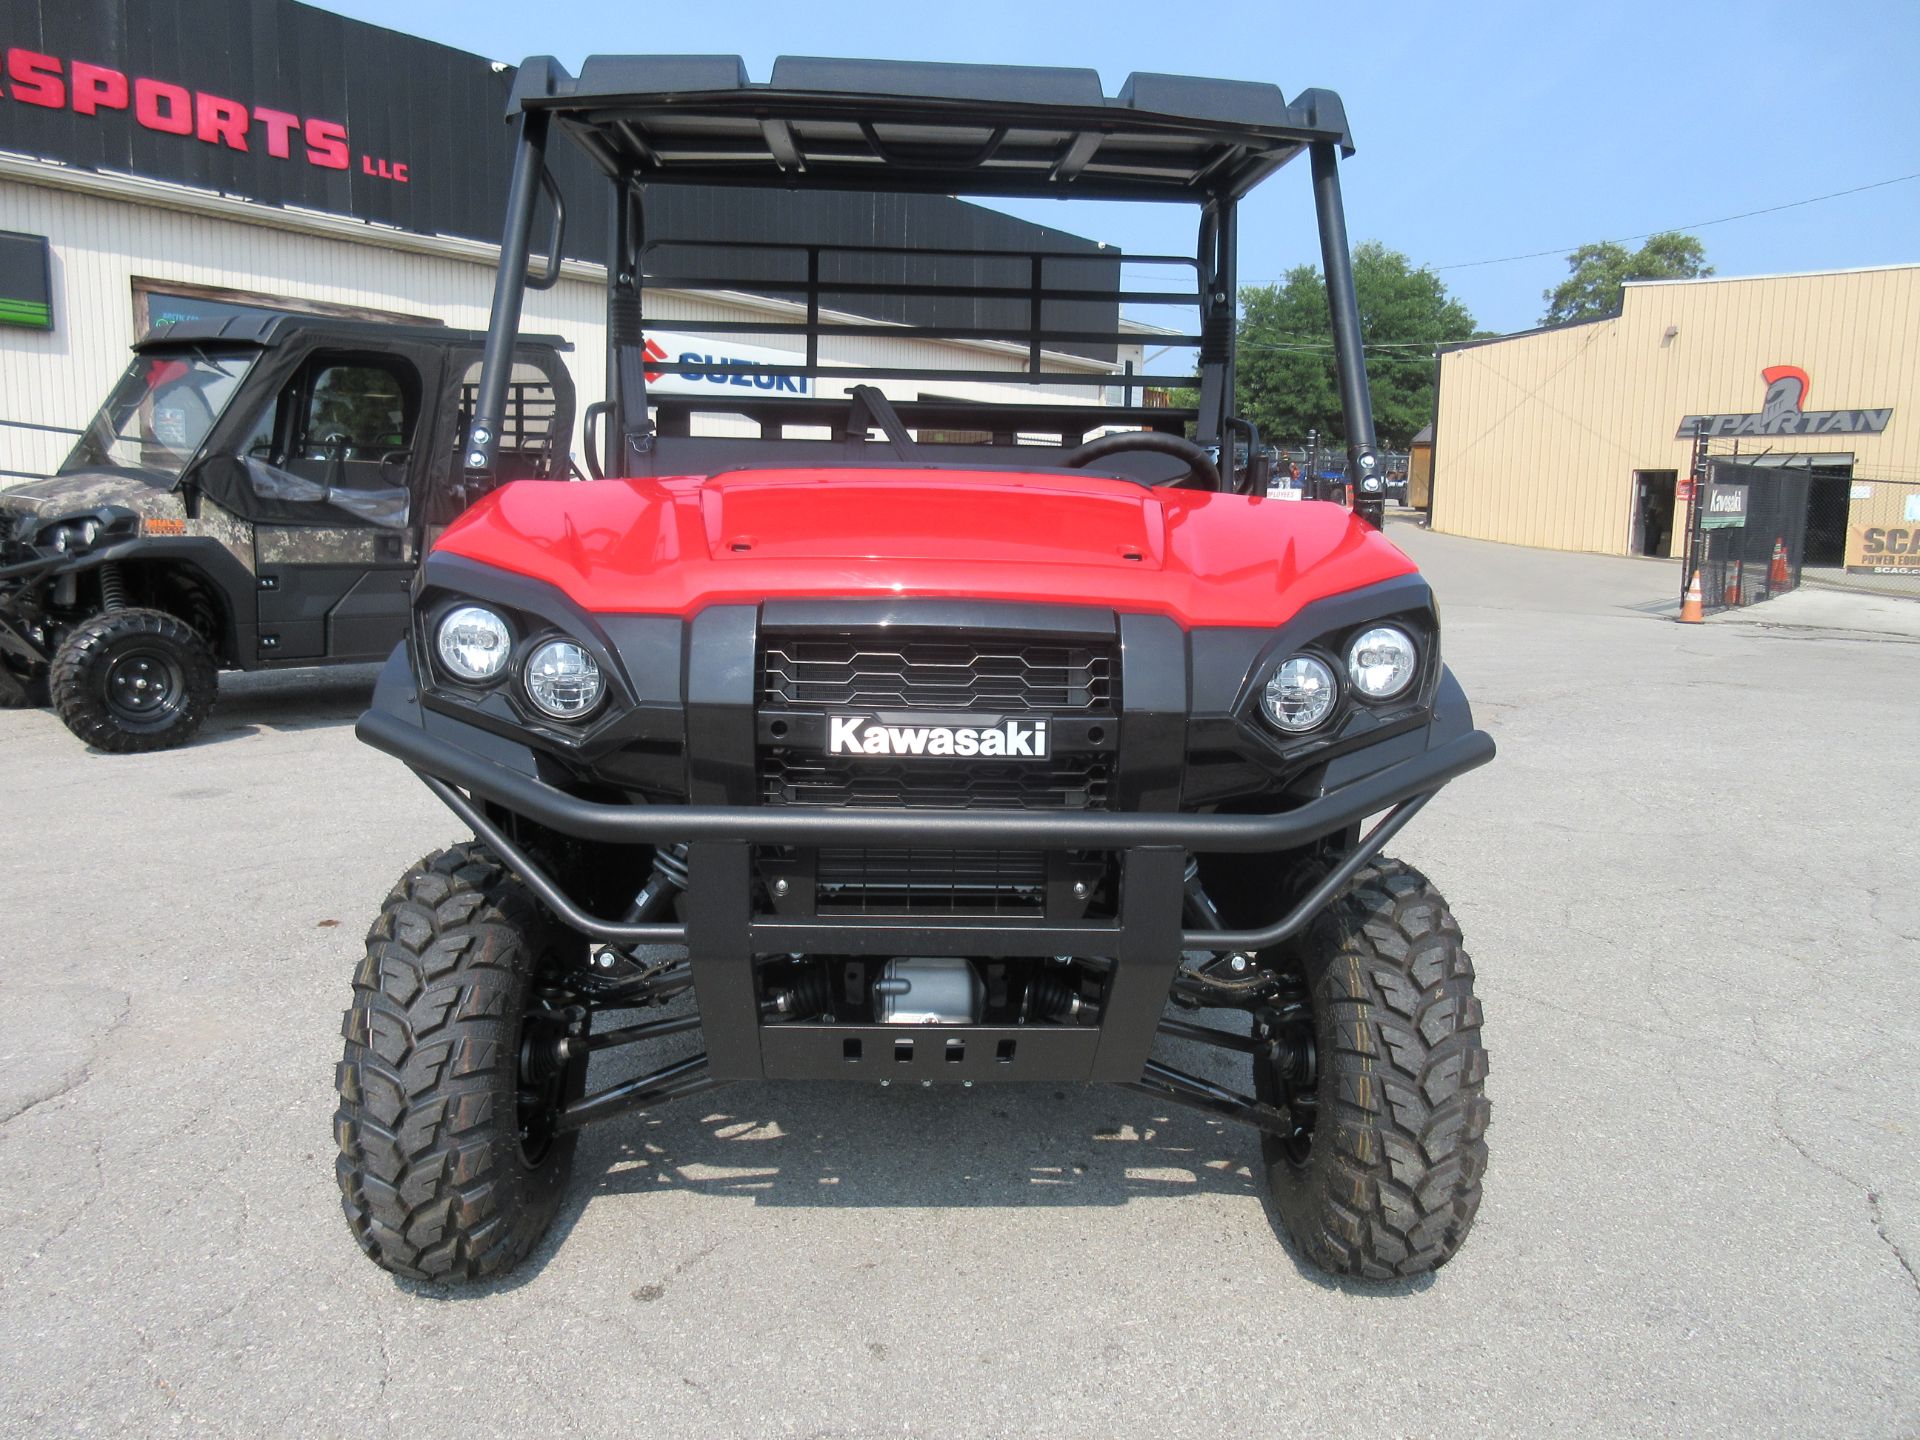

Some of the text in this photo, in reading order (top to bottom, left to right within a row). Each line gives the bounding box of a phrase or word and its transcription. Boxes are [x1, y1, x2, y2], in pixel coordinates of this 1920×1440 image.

[0, 47, 409, 182] SPORTS LLC
[679, 352, 807, 394] SUZUKI
[1677, 408, 1892, 437] SPARTAN
[1861, 554, 1895, 566] POWER
[1874, 566, 1920, 575] SCAG.c
[830, 717, 1046, 757] Kawasaki
